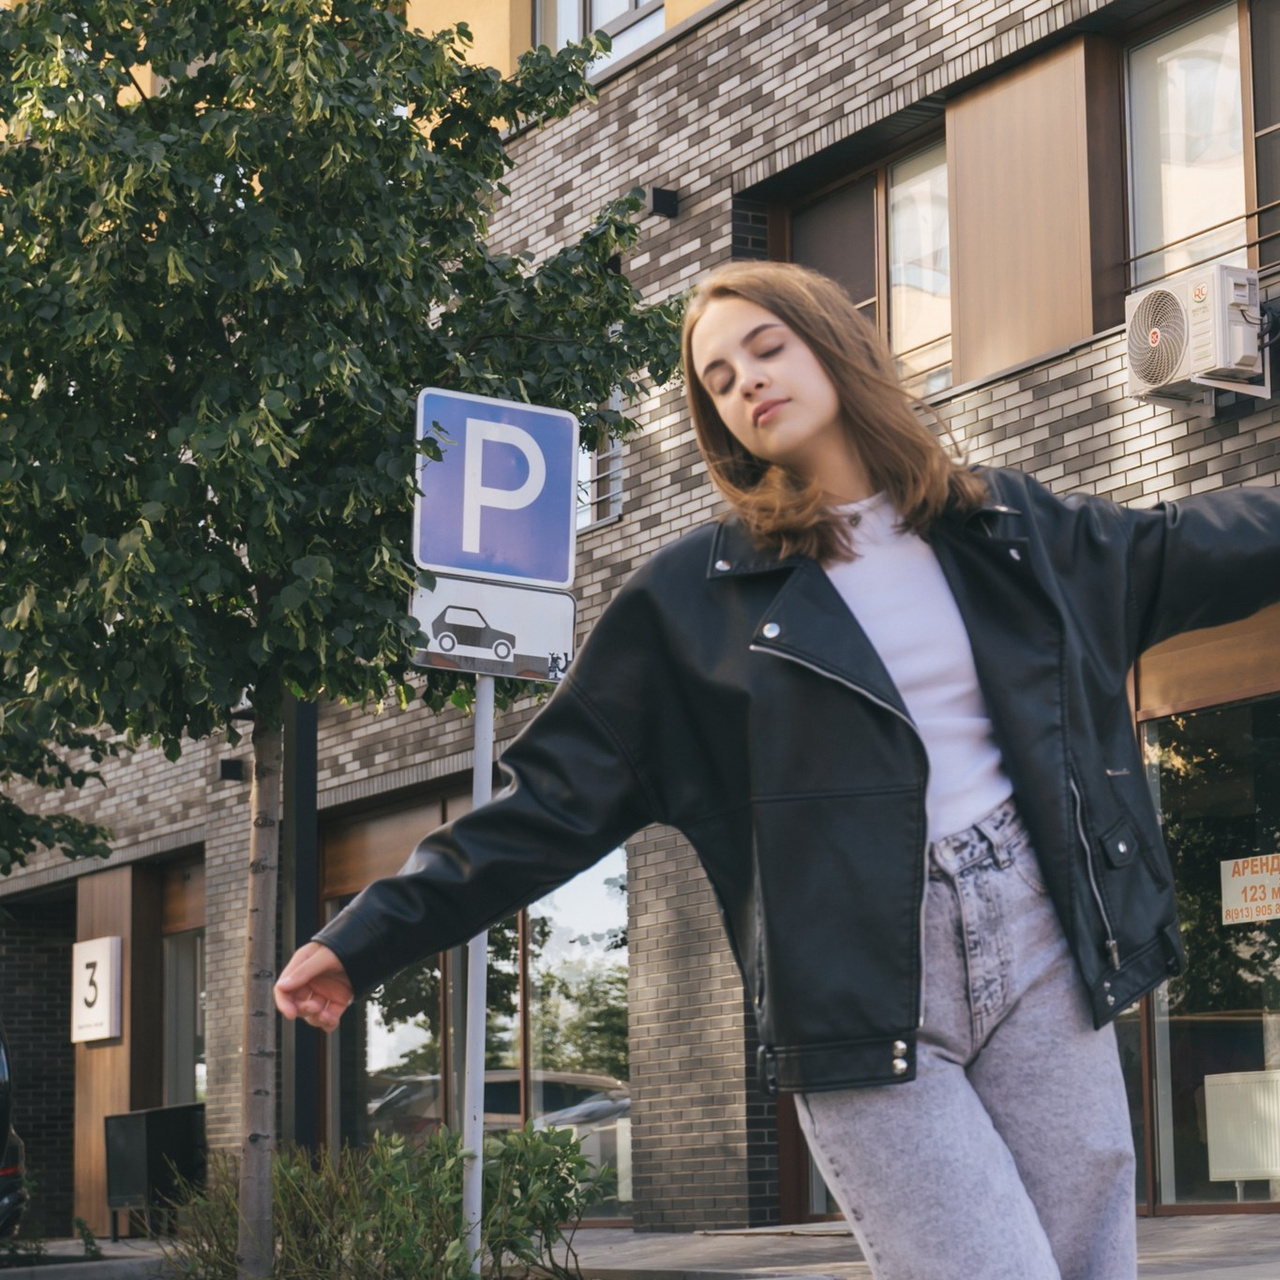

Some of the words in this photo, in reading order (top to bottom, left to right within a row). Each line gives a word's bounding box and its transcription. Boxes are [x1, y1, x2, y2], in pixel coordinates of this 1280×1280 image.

[462, 417, 546, 554] P
[1241, 884, 1267, 903] 123
[1225, 906, 1253, 921] 8(913)
[1255, 904, 1272, 916] 905
[84, 961, 98, 1009] 3
